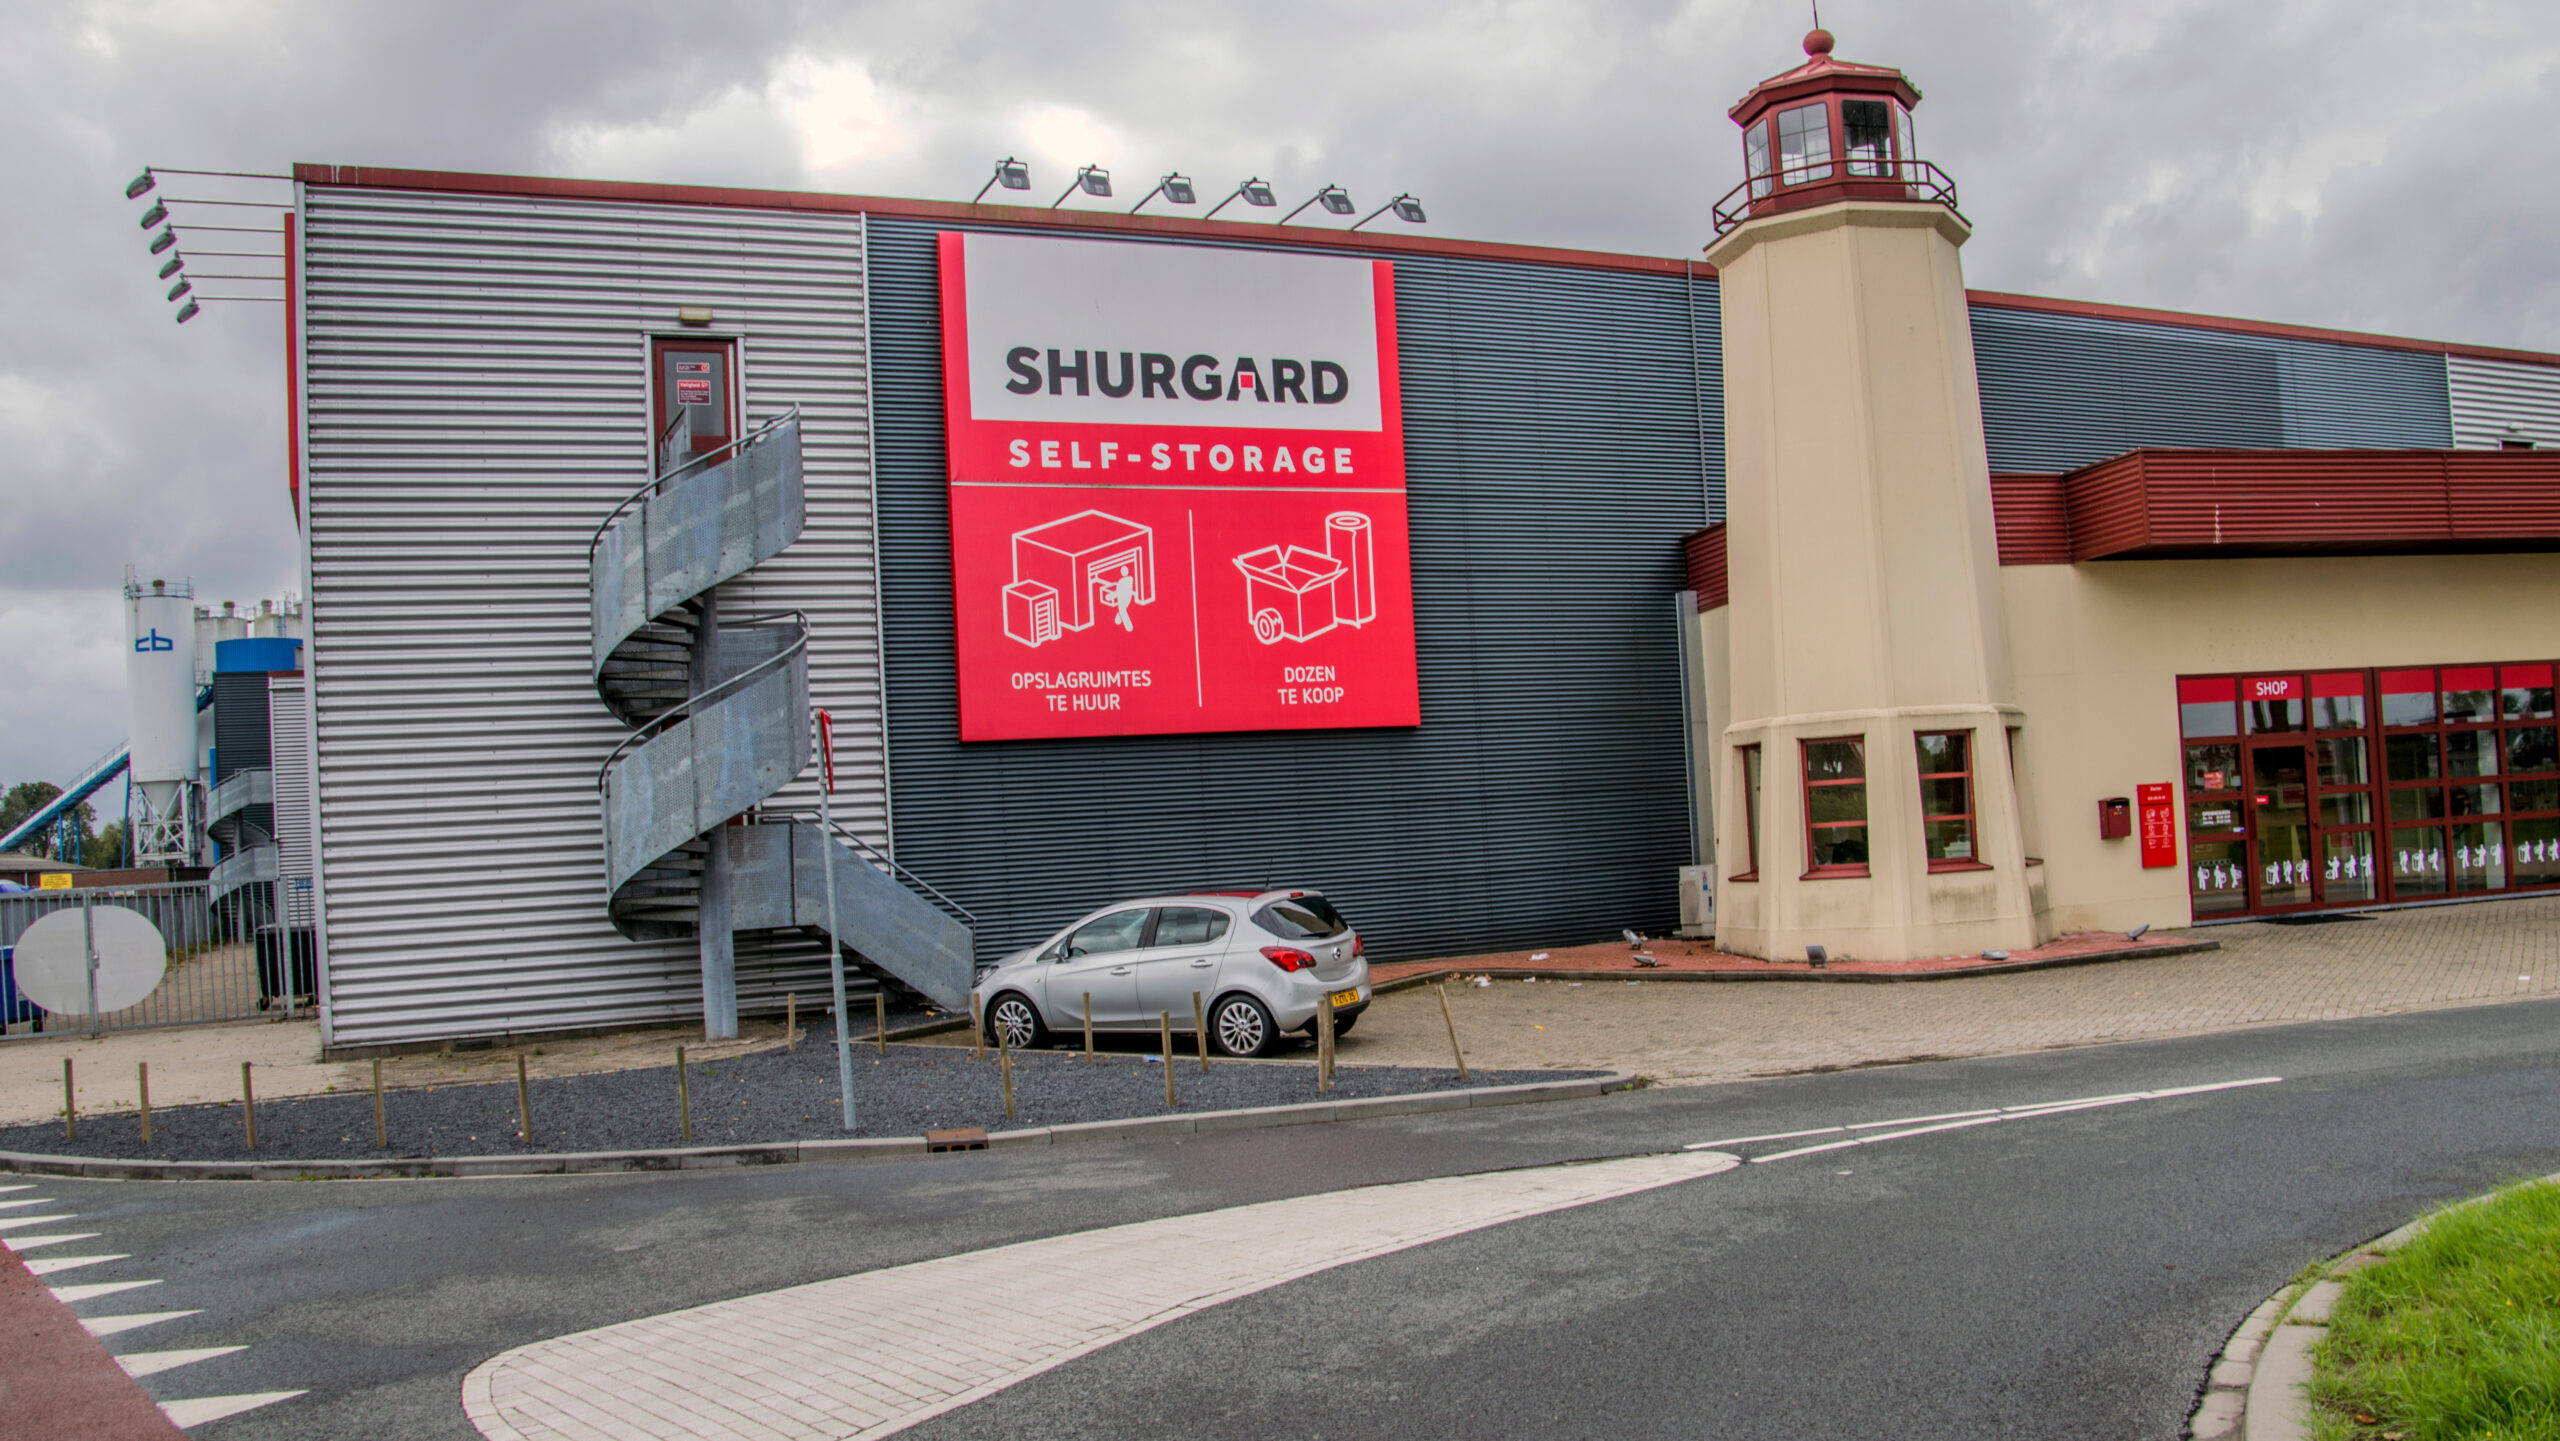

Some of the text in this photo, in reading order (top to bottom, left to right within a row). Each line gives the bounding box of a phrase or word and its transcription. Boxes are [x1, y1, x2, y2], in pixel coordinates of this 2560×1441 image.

[1004, 345, 1350, 406] SHURGARD
[1008, 438, 1355, 475] SELF-STORAGE
[1010, 670, 1152, 690] OPSLAGRUIMTES
[1283, 665, 1337, 684] DOZEN
[1277, 686, 1345, 705] TE KOOP
[2255, 680, 2289, 696] SHOP
[1045, 693, 1121, 712] TE HUUR
